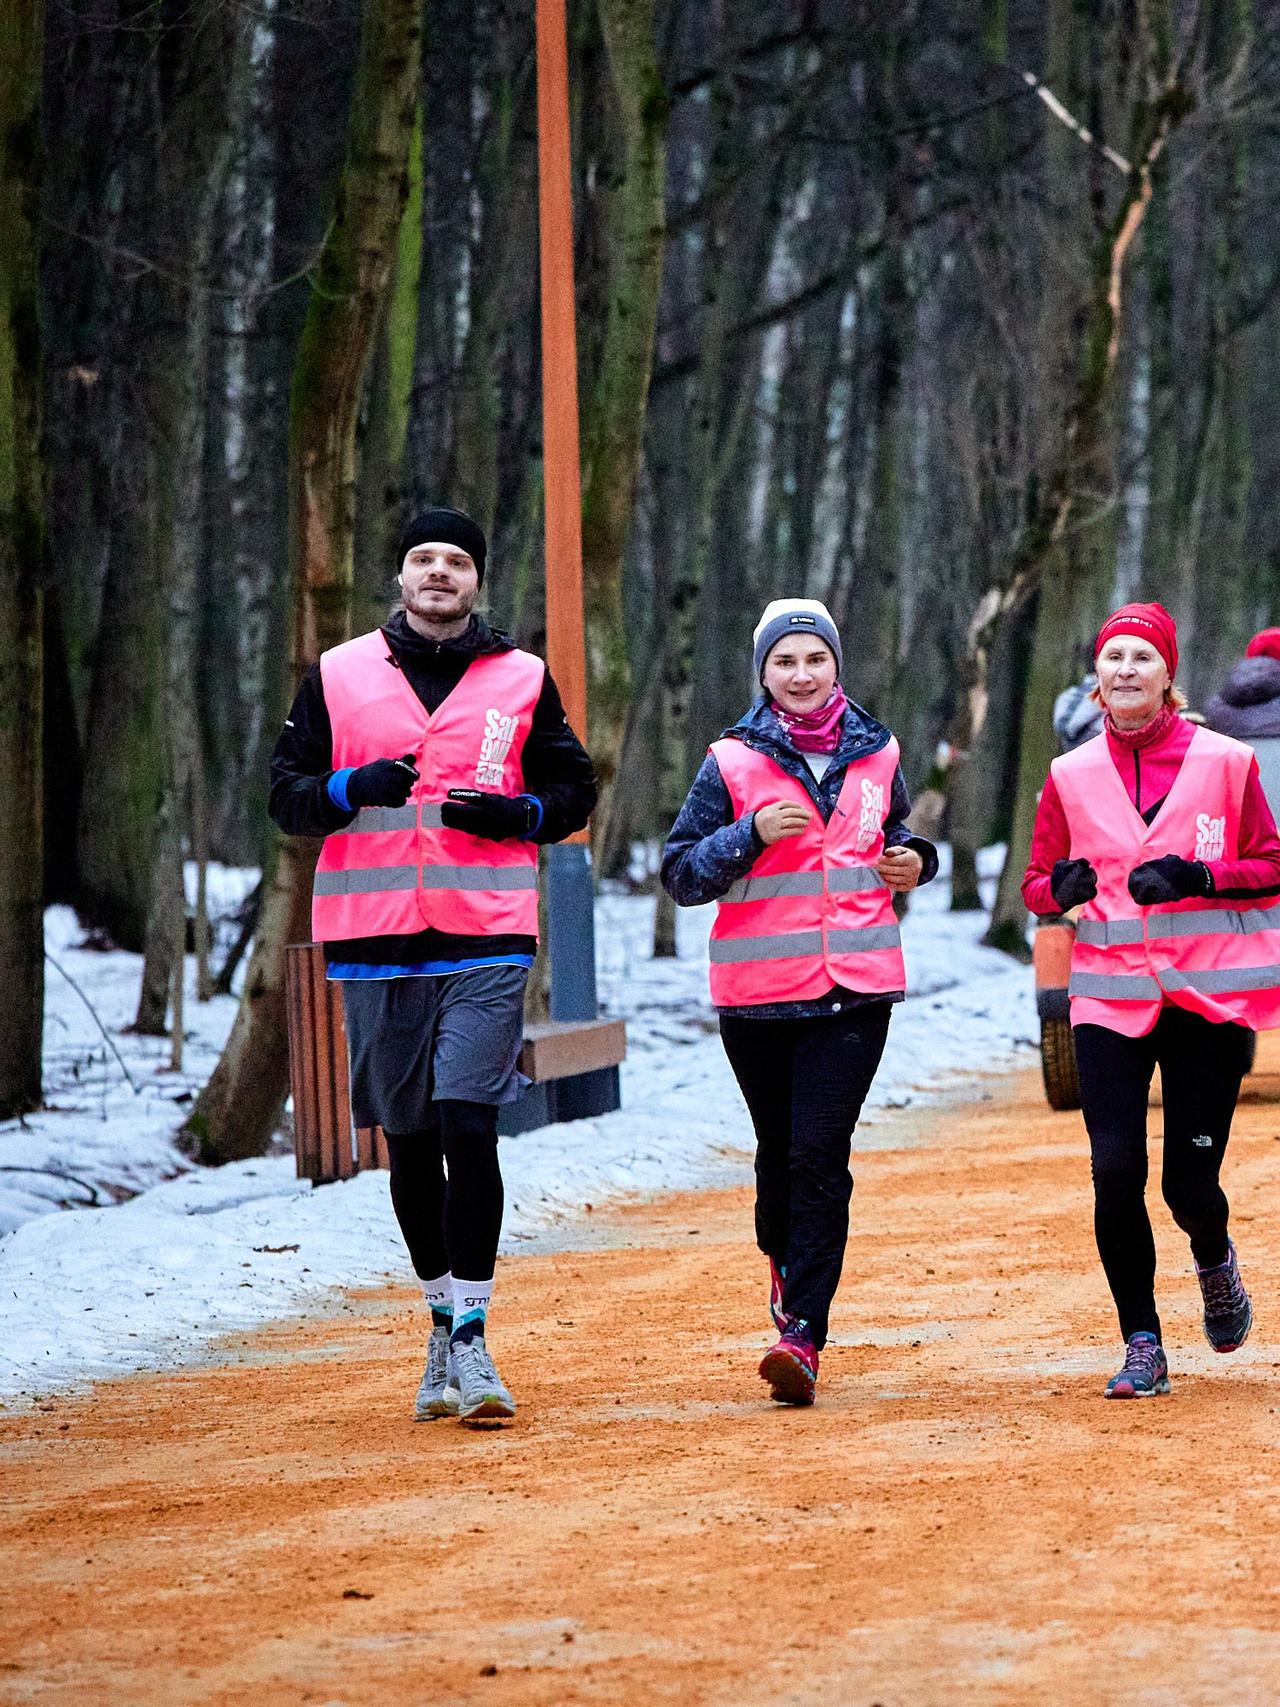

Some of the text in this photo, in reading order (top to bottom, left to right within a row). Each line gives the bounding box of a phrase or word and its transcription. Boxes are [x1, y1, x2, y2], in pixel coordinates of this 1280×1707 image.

[484, 708, 519, 742] Sat
[861, 778, 884, 813] Sat
[1196, 813, 1226, 844] Sat
